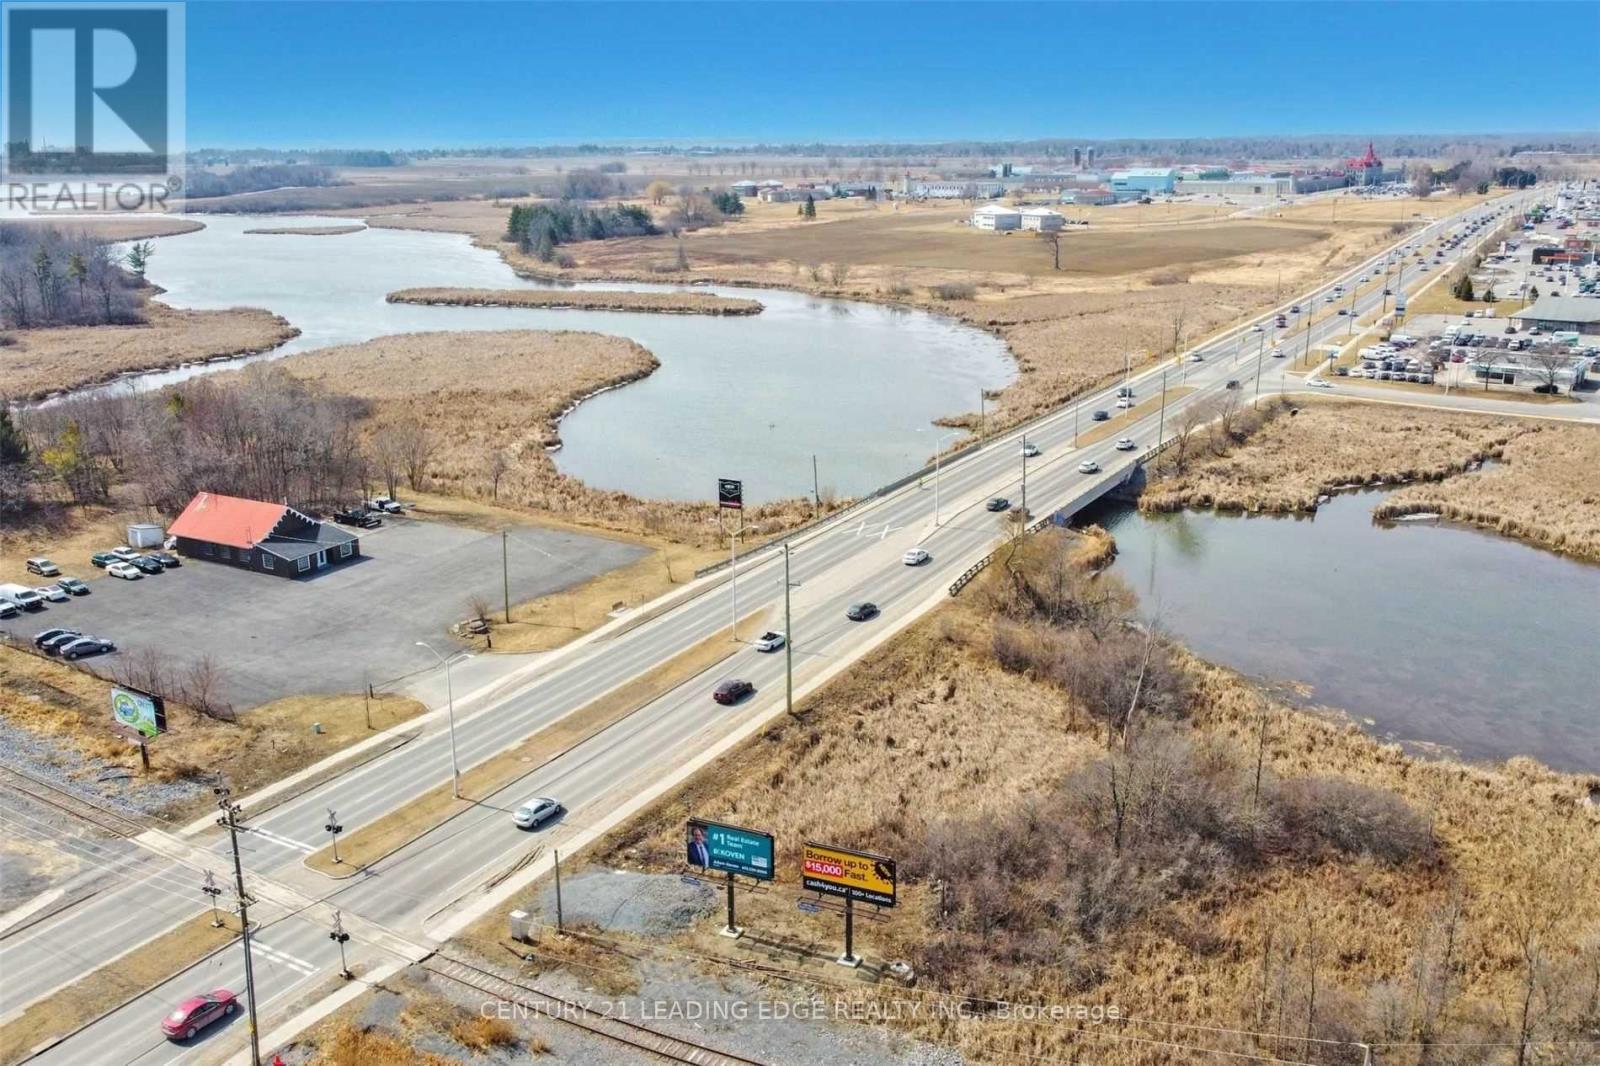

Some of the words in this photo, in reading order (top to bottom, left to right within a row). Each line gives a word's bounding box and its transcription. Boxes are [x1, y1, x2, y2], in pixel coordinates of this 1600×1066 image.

[712, 833, 725, 845] #1
[727, 834, 740, 842] Real
[740, 837, 759, 846] Estate
[727, 841, 743, 849] Team
[806, 850, 842, 865] Borrow
[844, 861, 857, 869] up
[859, 862, 869, 871] to
[805, 861, 842, 876] $15,000
[865, 891, 892, 903] Locations
